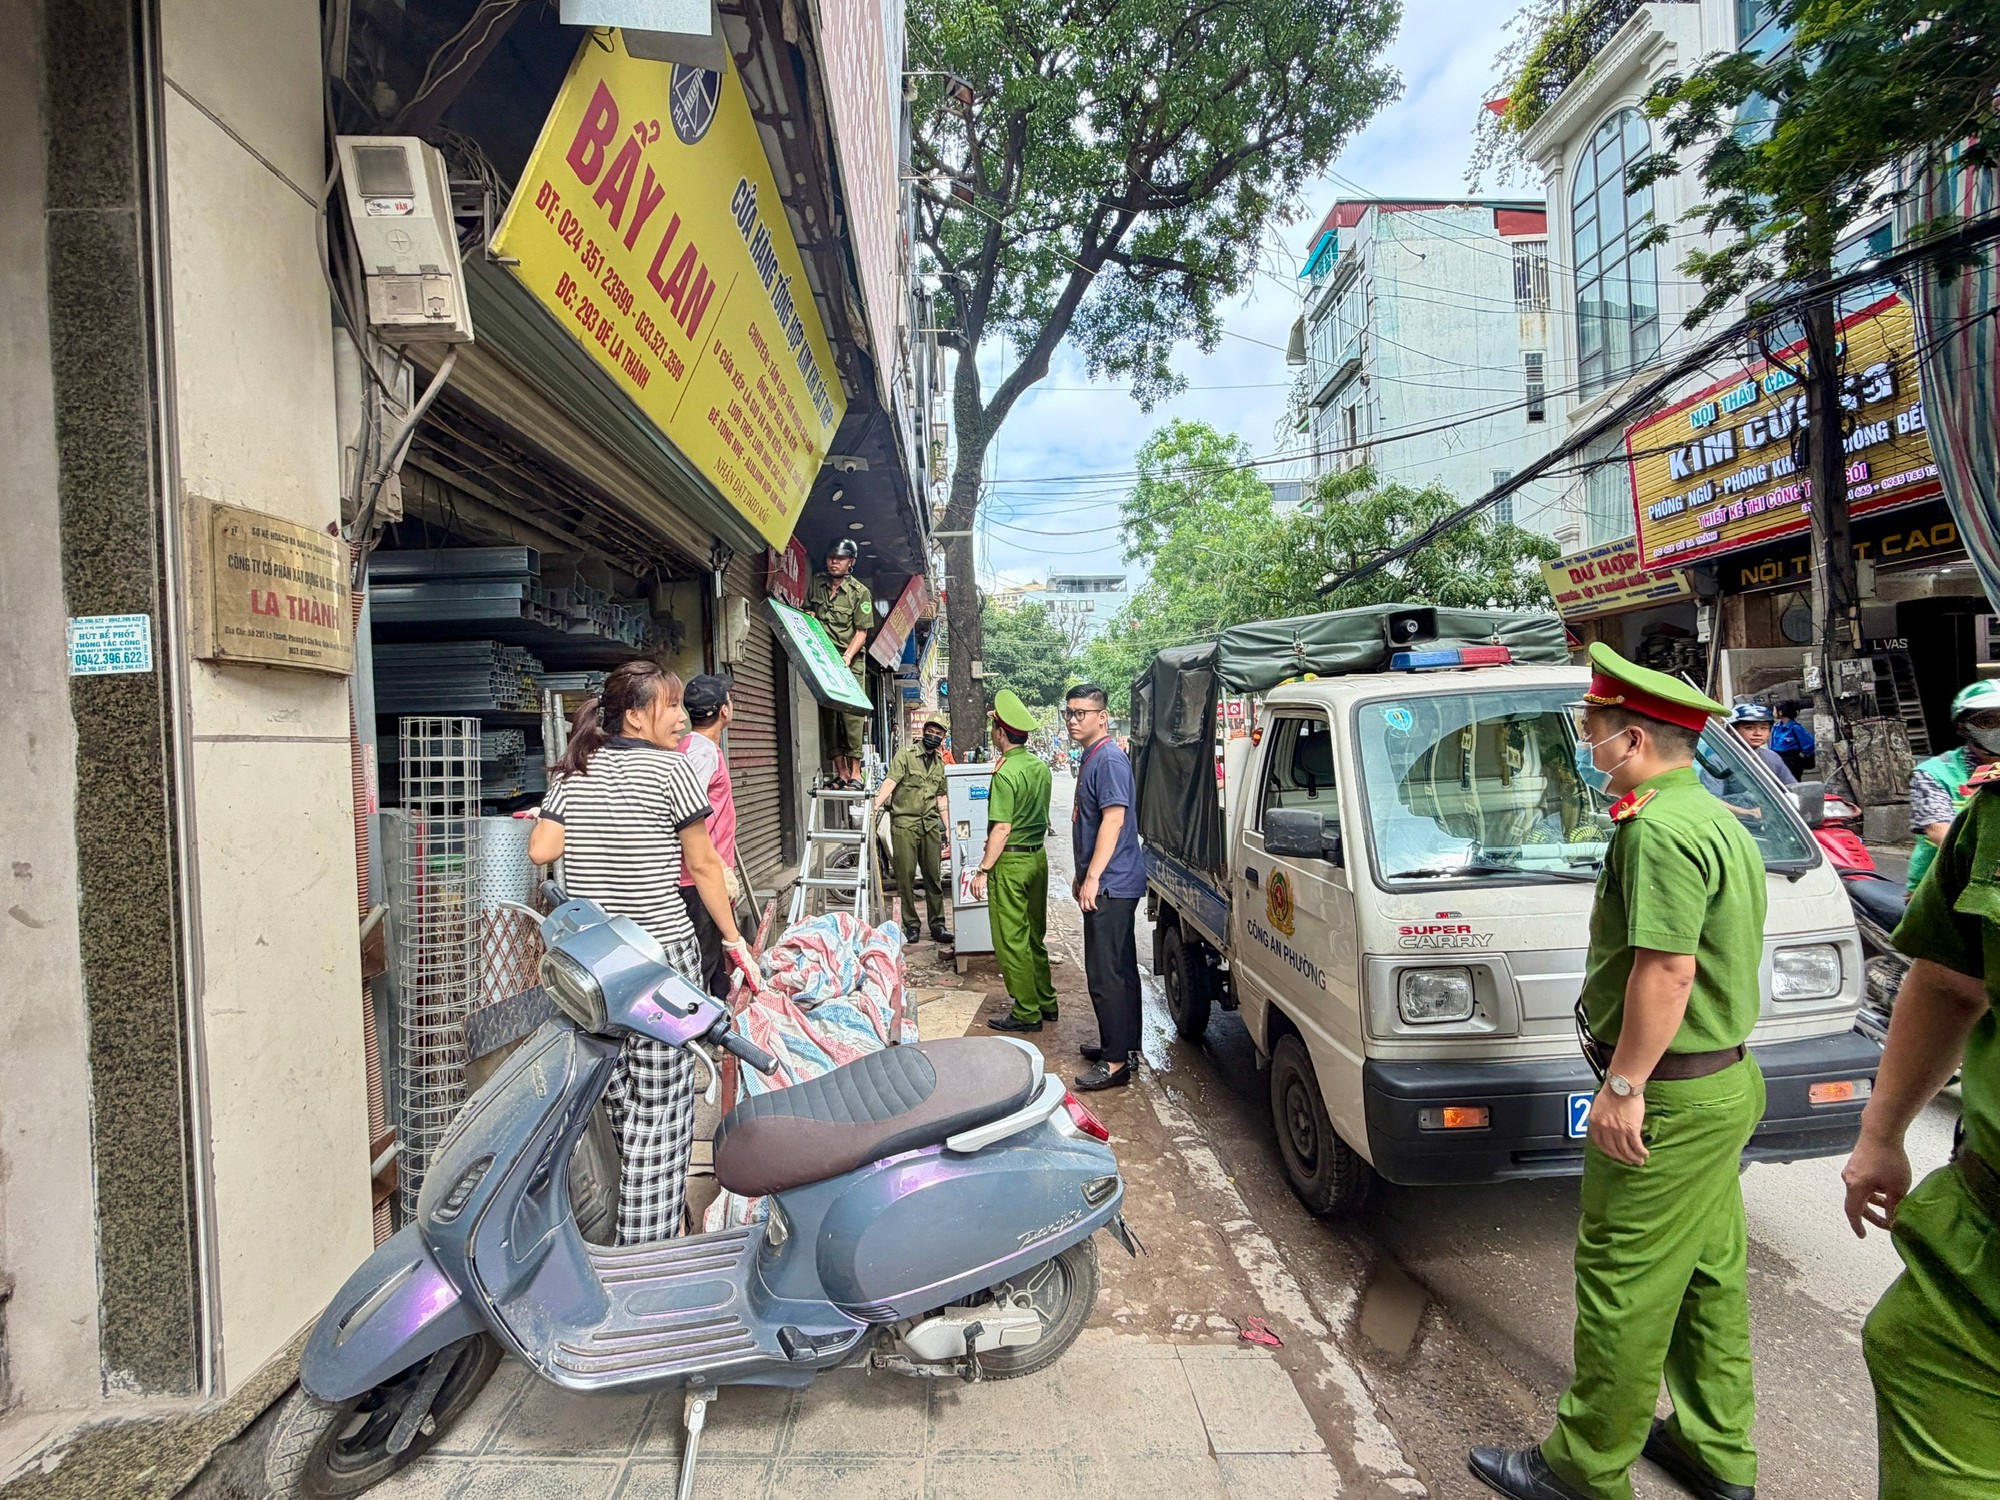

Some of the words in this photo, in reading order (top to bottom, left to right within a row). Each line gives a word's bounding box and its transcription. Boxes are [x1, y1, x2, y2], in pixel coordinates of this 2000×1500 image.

[672, 103, 690, 137] HLK
[566, 78, 666, 252] BẨY
[646, 211, 716, 341] LAN
[535, 179, 560, 224] ĐT:
[558, 209, 584, 253] 024
[580, 239, 605, 279] 351
[600, 267, 635, 317] 23599
[635, 310, 685, 382] 033.521.3599
[731, 177, 758, 243] CỬA
[750, 221, 778, 291] HÀNG
[770, 271, 794, 329] TỔNG
[786, 312, 804, 352] HỢP
[796, 339, 813, 378] KIM
[555, 271, 578, 310] ĐC:
[575, 295, 600, 332] 293
[594, 317, 615, 349] ĐÊ
[608, 333, 625, 362] LA
[620, 347, 651, 390] THÀNH
[713, 338, 722, 355] U
[1689, 402, 1716, 428] NỘI
[1720, 381, 1757, 413] THẤT
[716, 418, 734, 446] TÔNG
[1668, 430, 1735, 481] KIM
[713, 455, 736, 485] NHẬN
[743, 490, 760, 514] THEO
[1647, 496, 1683, 521] PHÒNG
[1688, 480, 1713, 506] NGỦ
[1723, 467, 1767, 494] PHÒNG
[1881, 474, 1905, 489] 0985
[1905, 469, 1924, 480] 185
[1697, 504, 1726, 529] THIẾT
[1729, 497, 1744, 519] KẾ
[1745, 493, 1766, 515] THI
[1767, 485, 1801, 508] CÔNG
[228, 552, 250, 571] CÔNG
[251, 559, 260, 574] TY
[262, 557, 272, 576] CỔ
[1568, 561, 1597, 584] DƯ
[1597, 552, 1638, 576] HỢP
[1741, 557, 1782, 585] NỘI
[1882, 522, 1956, 556] CAO
[251, 588, 280, 618] LA
[286, 594, 339, 630] THÀNH
[79, 631, 97, 640] HÚT
[113, 629, 136, 639] PHỐT
[75, 651, 142, 666] 0942.396.622
[1398, 925, 1471, 935] SUPER
[1398, 934, 1493, 948] CARRY
[1247, 919, 1269, 948] CÔNG
[1270, 936, 1282, 958] AN
[1283, 944, 1326, 991] PHƯỜNG
